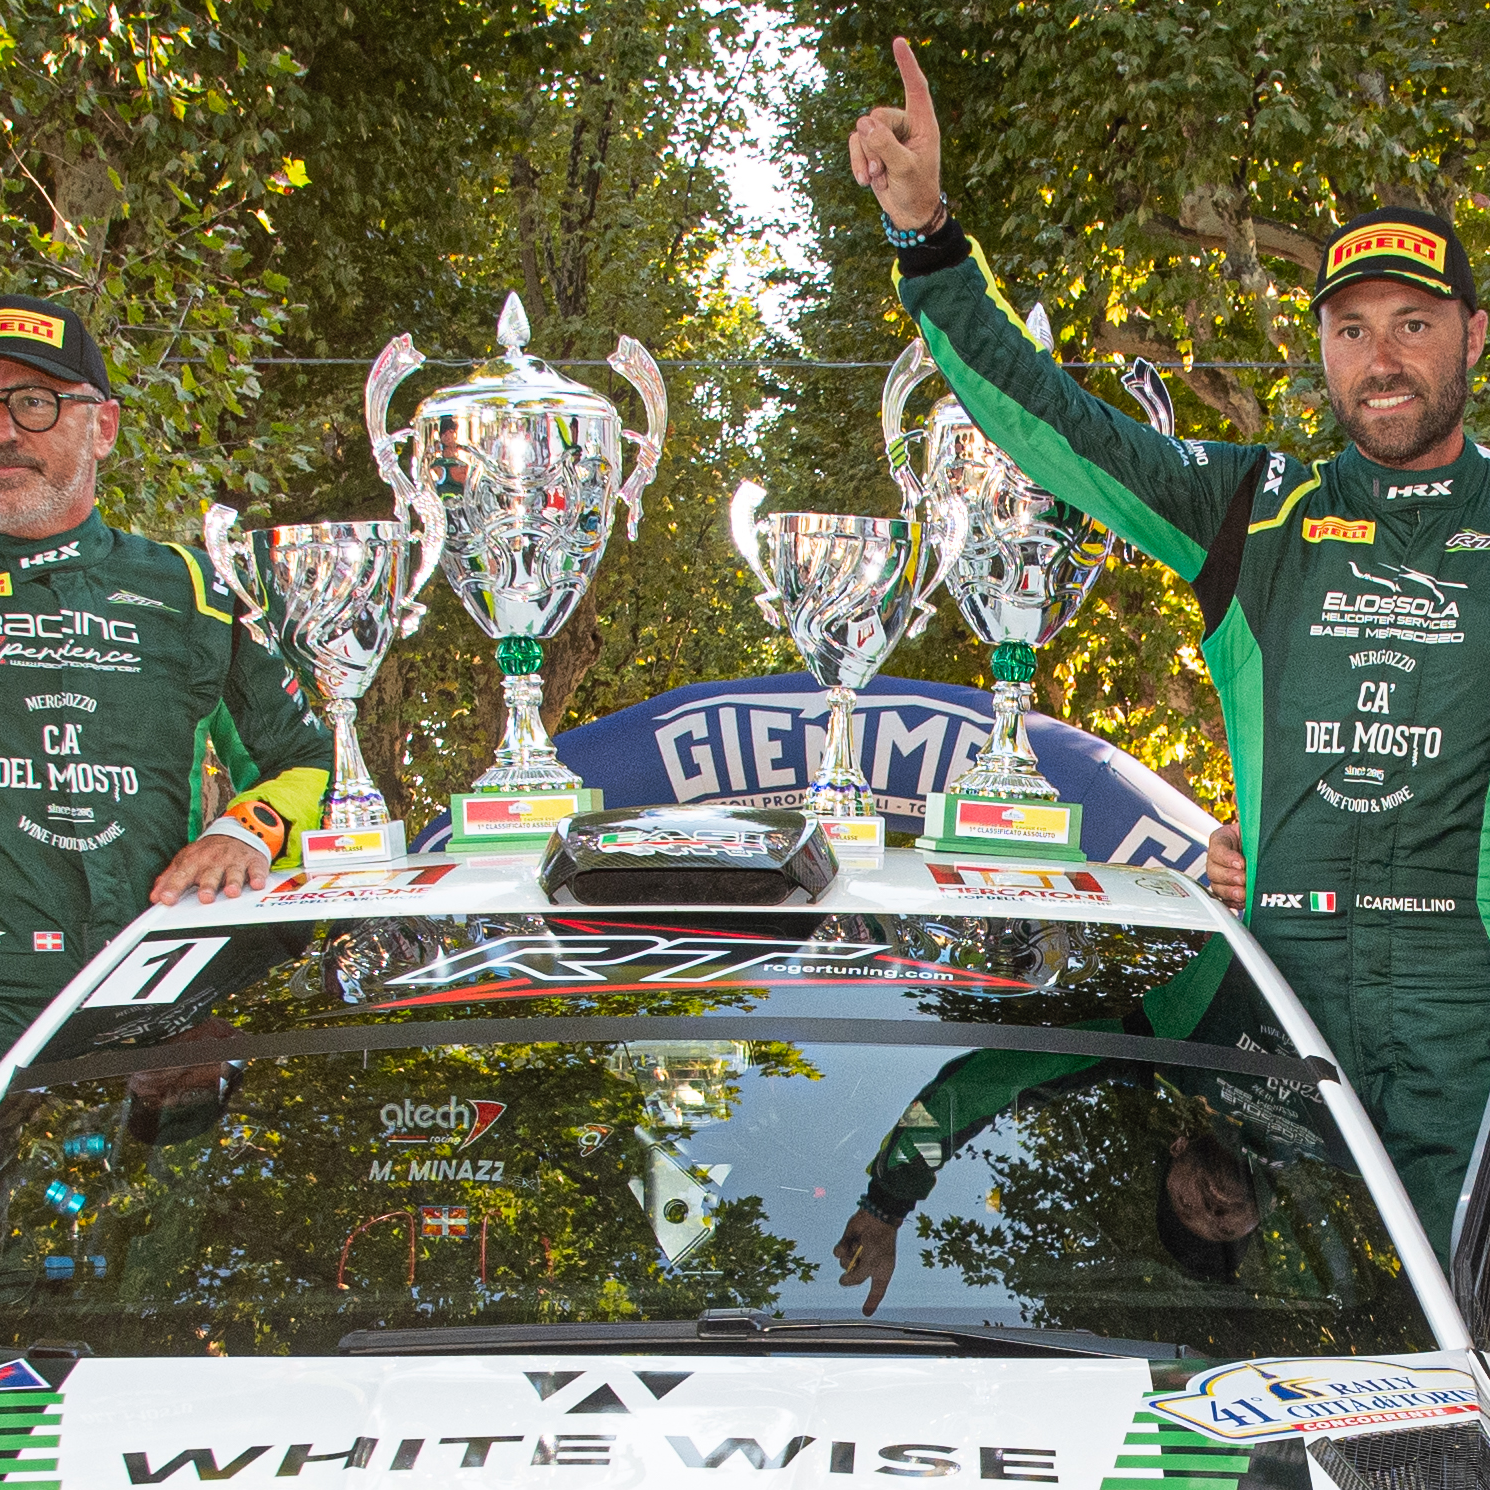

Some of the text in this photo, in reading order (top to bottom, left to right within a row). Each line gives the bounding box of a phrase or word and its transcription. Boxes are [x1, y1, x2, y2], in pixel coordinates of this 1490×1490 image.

[1333, 228, 1437, 266] PIRELLI
[1387, 479, 1454, 499] HRX
[1308, 521, 1369, 539] PIRELLI
[20, 541, 80, 569] HRX
[1321, 611, 1457, 629] HELICOPTER SERVICES
[1310, 625, 1464, 644] BASE MERGOZZO
[1348, 649, 1417, 674] MERGOZZO
[1357, 681, 1396, 715] CA'
[1305, 721, 1442, 767] DEL MOSTO
[48, 763, 139, 801] MOSTO
[1316, 779, 1414, 813] WINE FOOD & MORE
[17, 815, 51, 844] WINE
[97, 820, 126, 848] MORE
[486, 822, 530, 830] CLASSIFICATO
[977, 826, 1056, 840] CLASSIFICATO ASSOLUTO
[261, 886, 430, 903] MERCATONE
[939, 887, 1111, 901] MERCATONE
[1261, 893, 1455, 912] HRX I.CARMELLINO
[763, 961, 955, 983] rogertuning.com
[380, 1097, 470, 1131] atech
[368, 1159, 396, 1181] M.
[1325, 1377, 1419, 1395] RALLY
[1287, 1394, 1393, 1418] CITTÀ di
[1303, 1408, 1447, 1431] CONCORRENTE
[121, 1434, 1058, 1486] WHITE WISE
